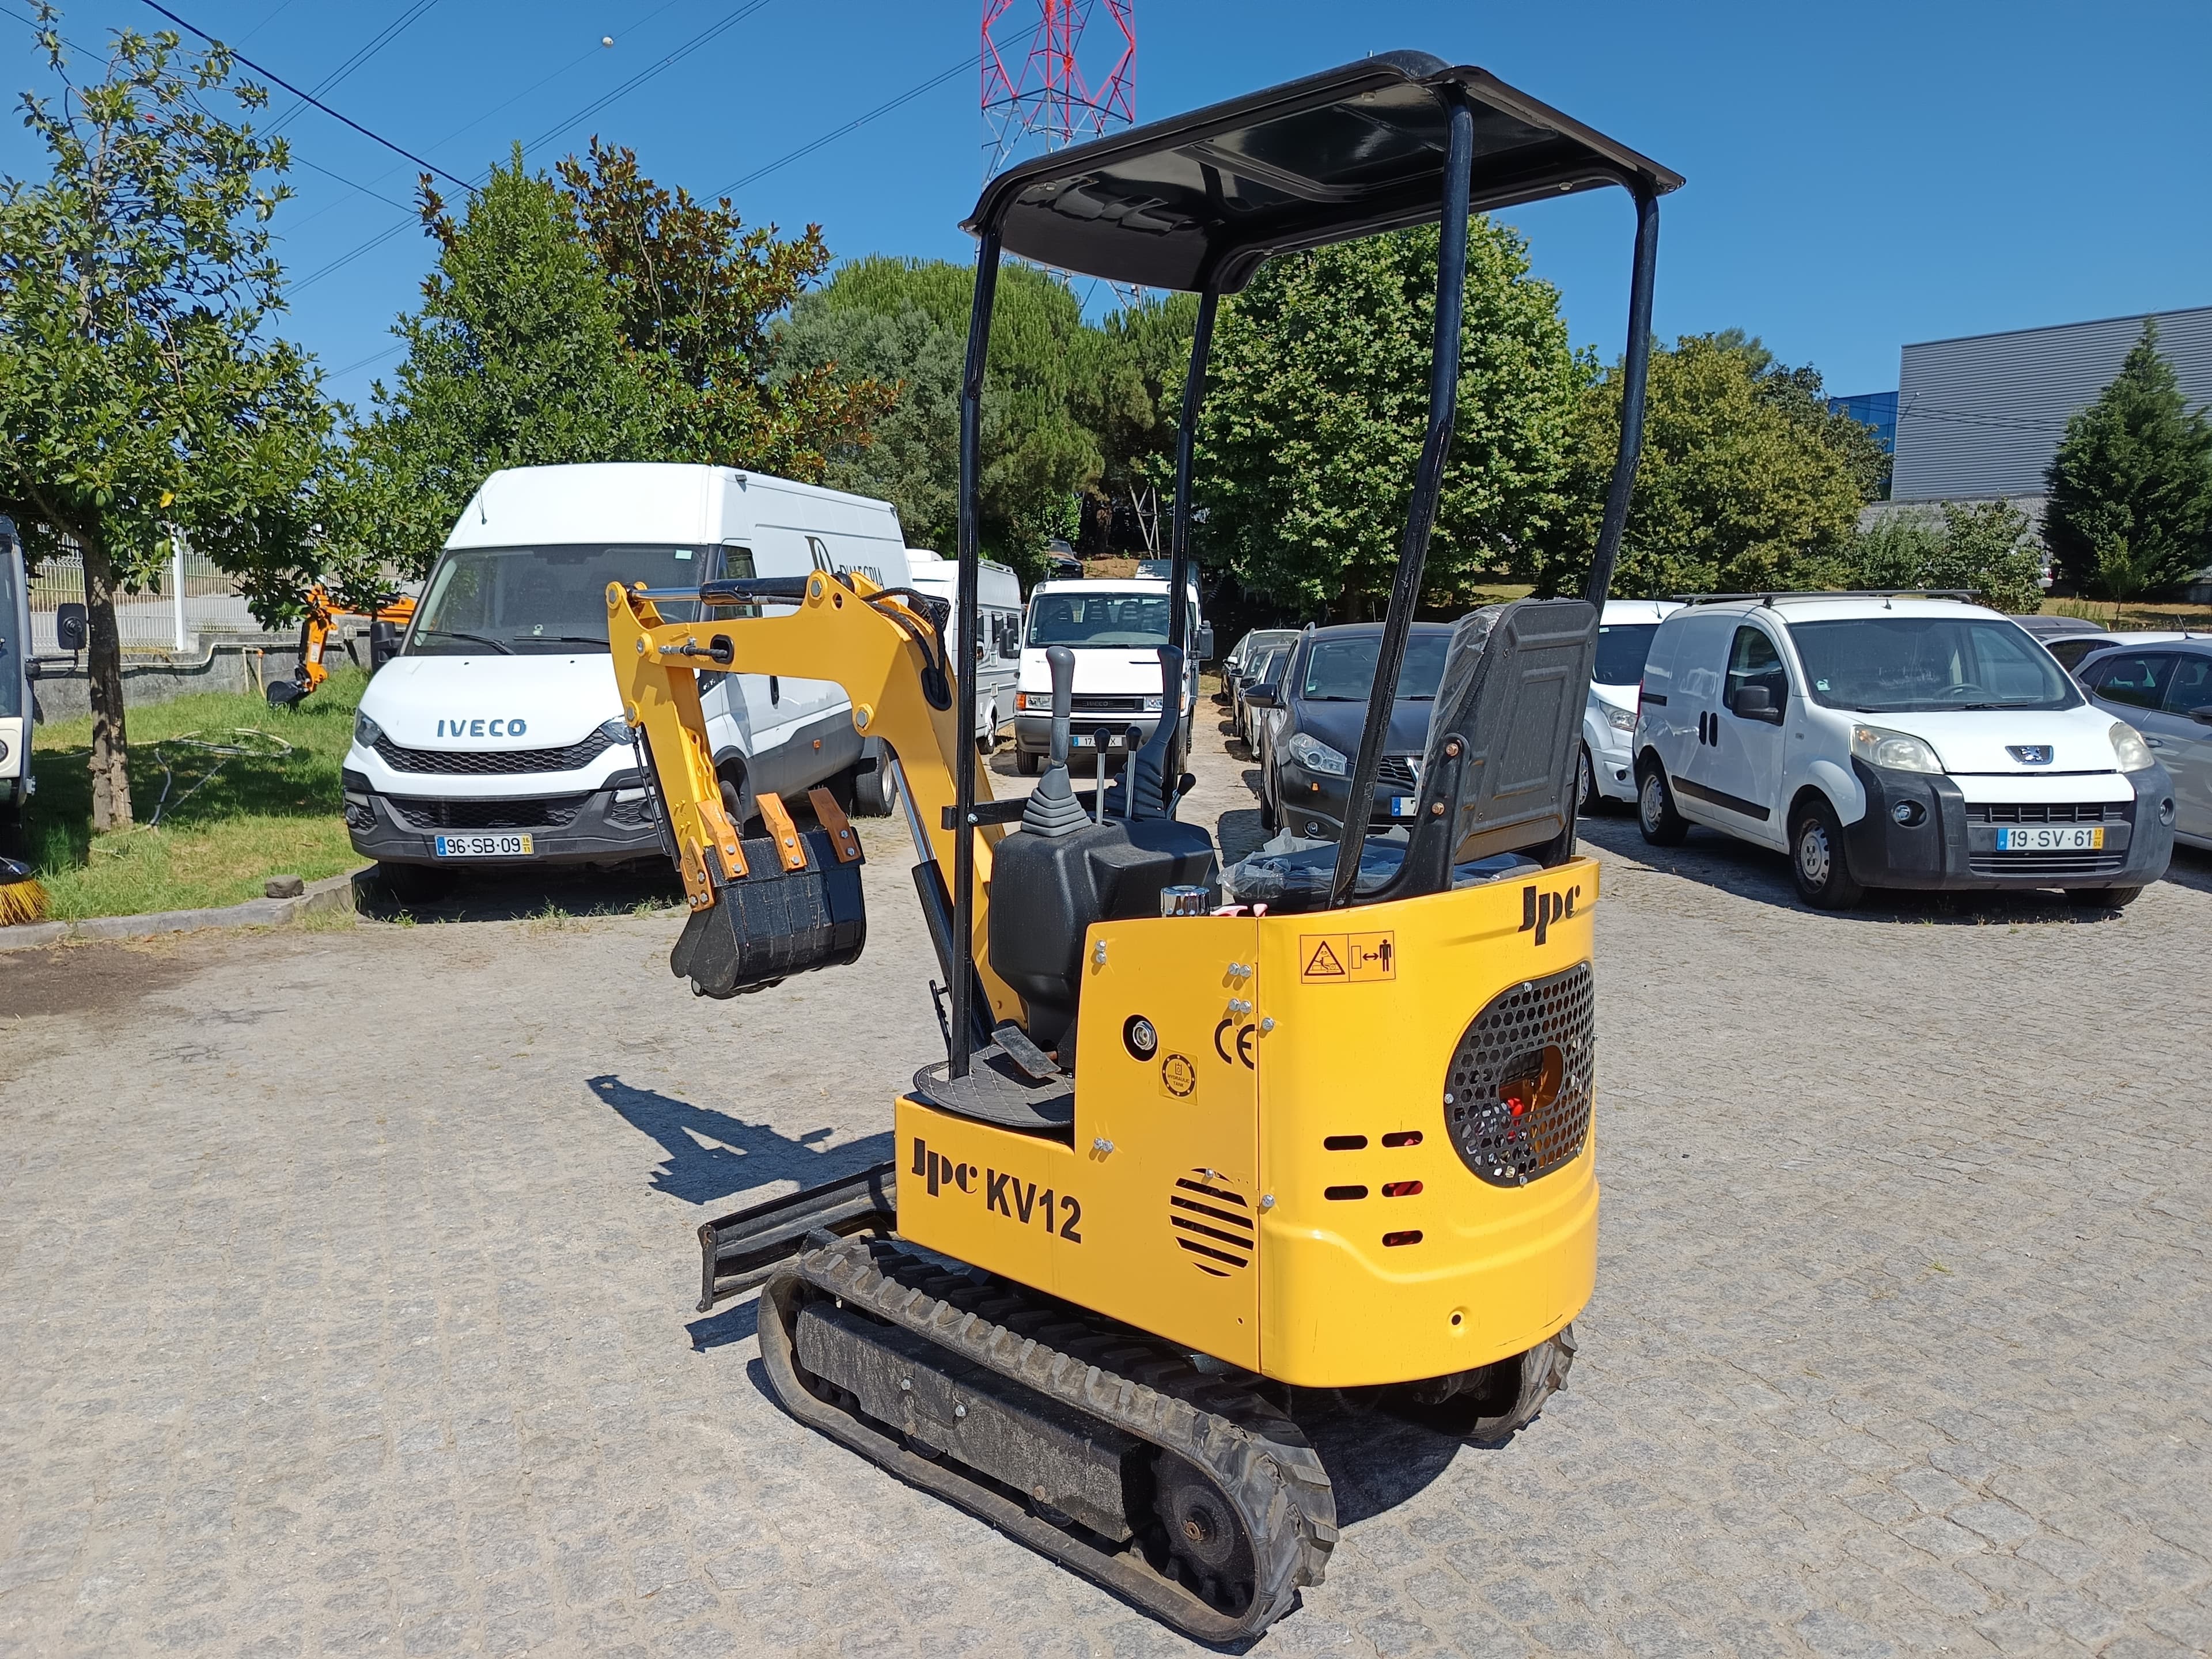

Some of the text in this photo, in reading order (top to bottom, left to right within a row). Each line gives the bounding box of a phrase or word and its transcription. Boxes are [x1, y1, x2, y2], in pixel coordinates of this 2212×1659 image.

[437, 719, 527, 737] IVECO
[1168, 1074, 1190, 1084] HYDRAULIC
[987, 1168, 1082, 1244] KV12
